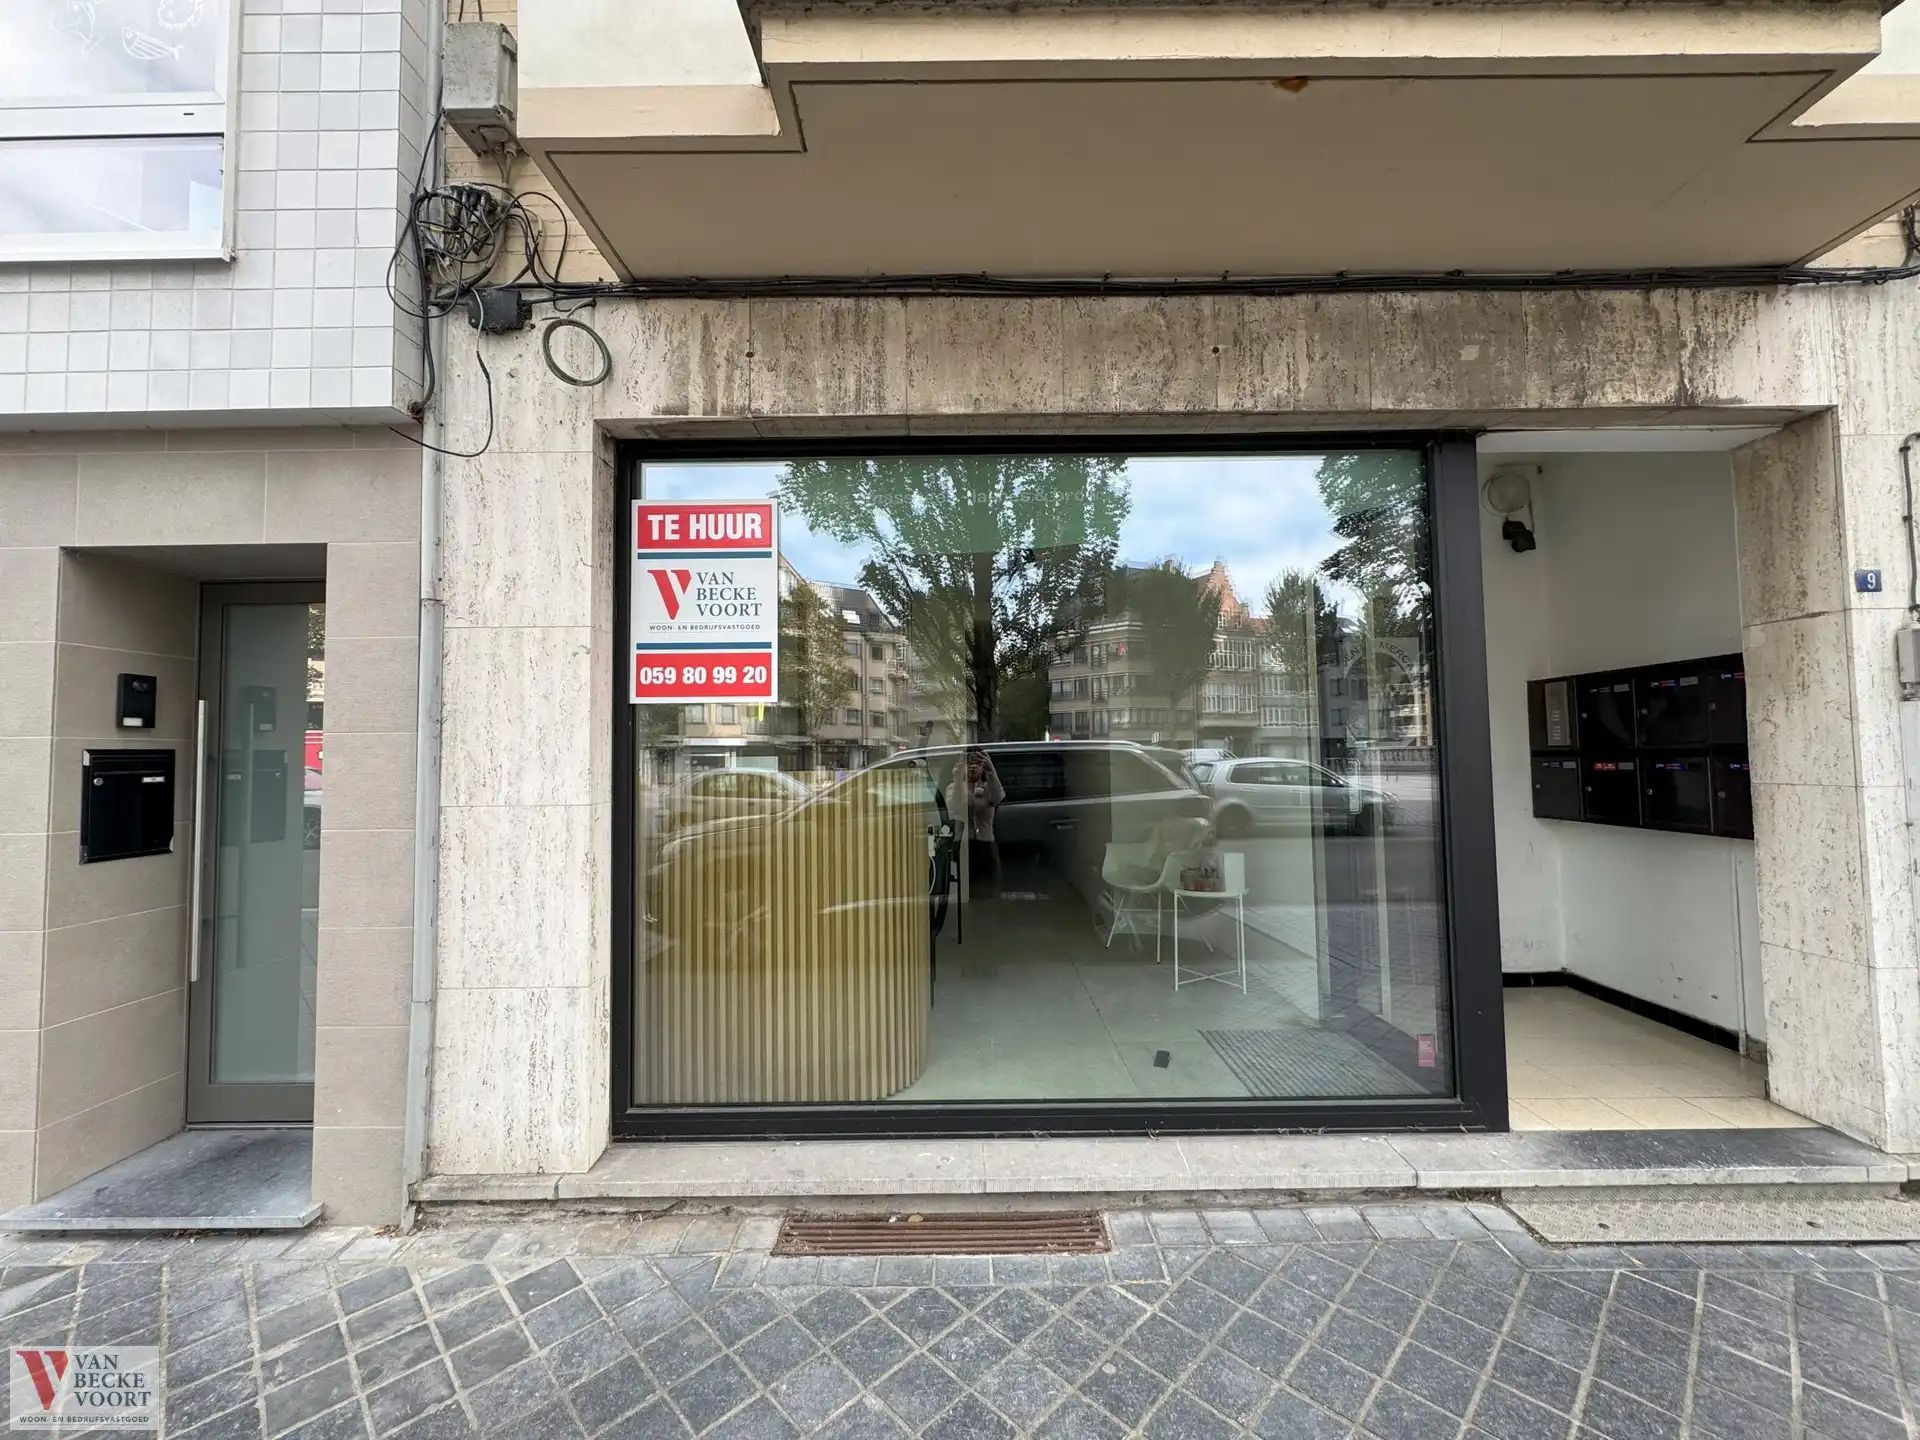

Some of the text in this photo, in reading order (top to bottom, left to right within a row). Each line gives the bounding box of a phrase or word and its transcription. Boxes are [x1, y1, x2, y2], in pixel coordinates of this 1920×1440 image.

[648, 512, 762, 541] TE HUUR
[696, 571, 734, 585] VAN
[1867, 572, 1876, 589] 9
[696, 587, 757, 600] BECKE
[696, 603, 762, 616] VOORT
[690, 623, 761, 631] BEDRIJFSVASTGOED
[639, 666, 767, 684] 059 80 99 20
